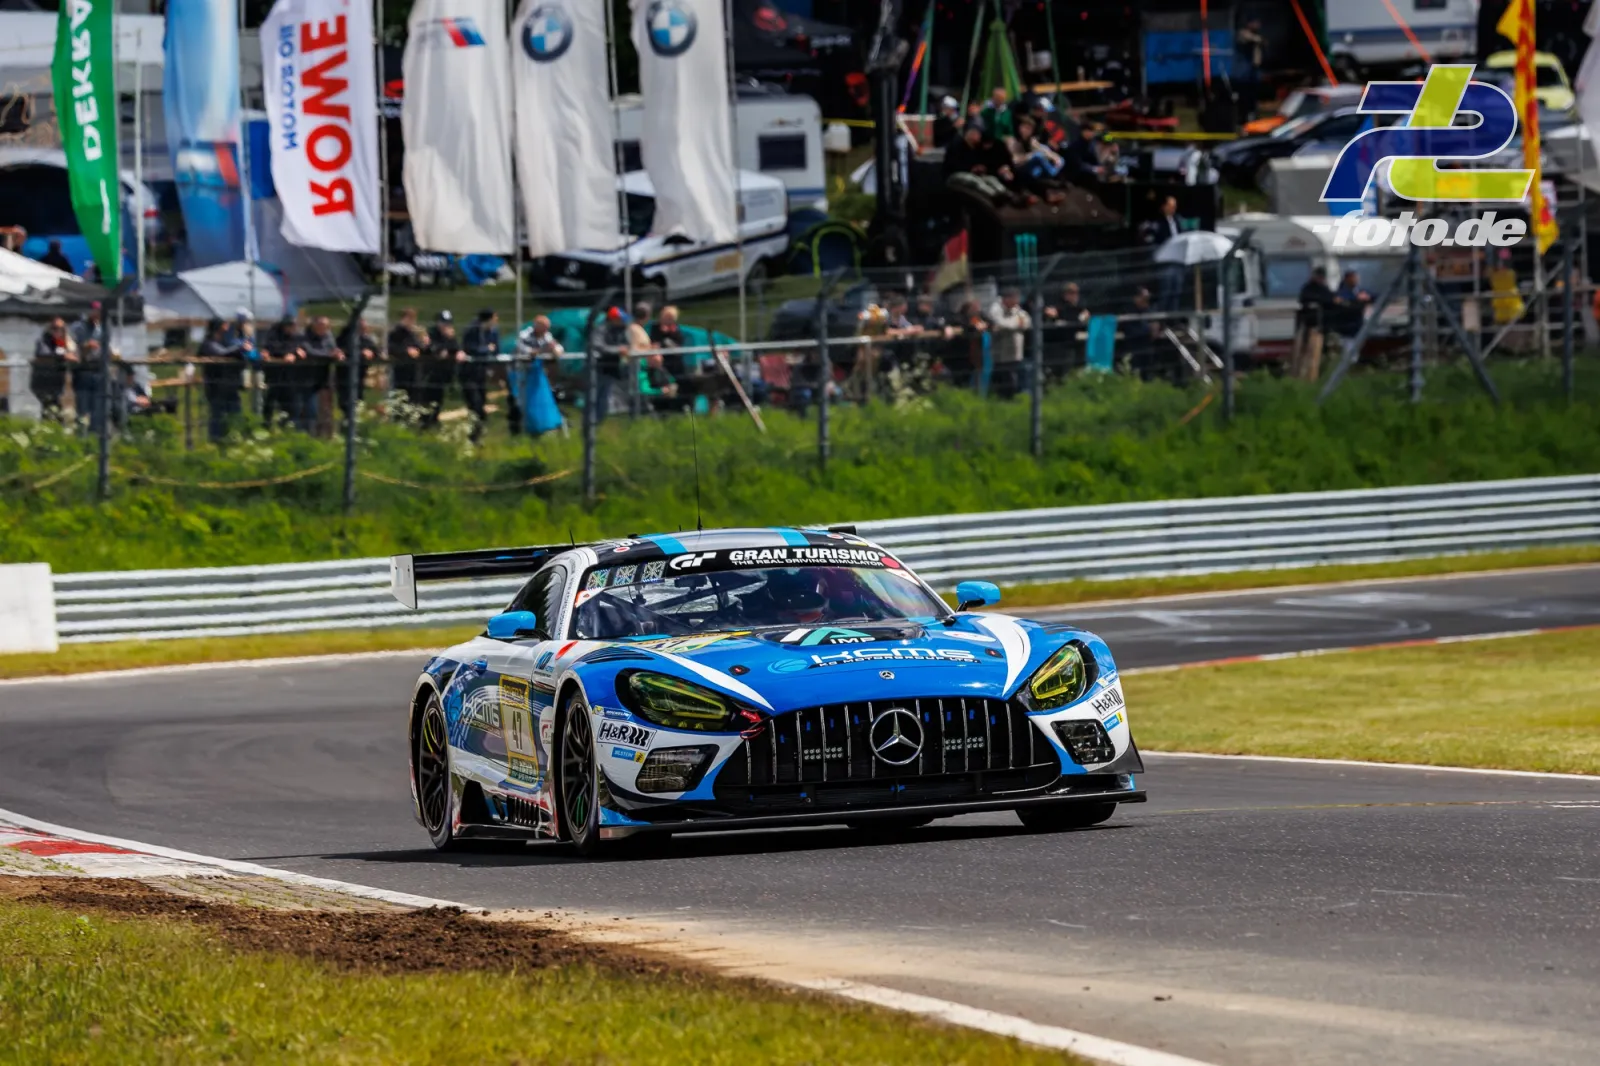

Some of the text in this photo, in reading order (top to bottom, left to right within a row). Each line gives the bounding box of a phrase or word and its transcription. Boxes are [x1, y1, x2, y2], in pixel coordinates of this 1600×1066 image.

[729, 548, 788, 561] GRAN
[829, 558, 884, 567] SIMULATOR
[830, 636, 876, 644] IMP
[810, 647, 976, 664] KCMG
[512, 711, 523, 751] 47
[599, 722, 629, 741] H&R
